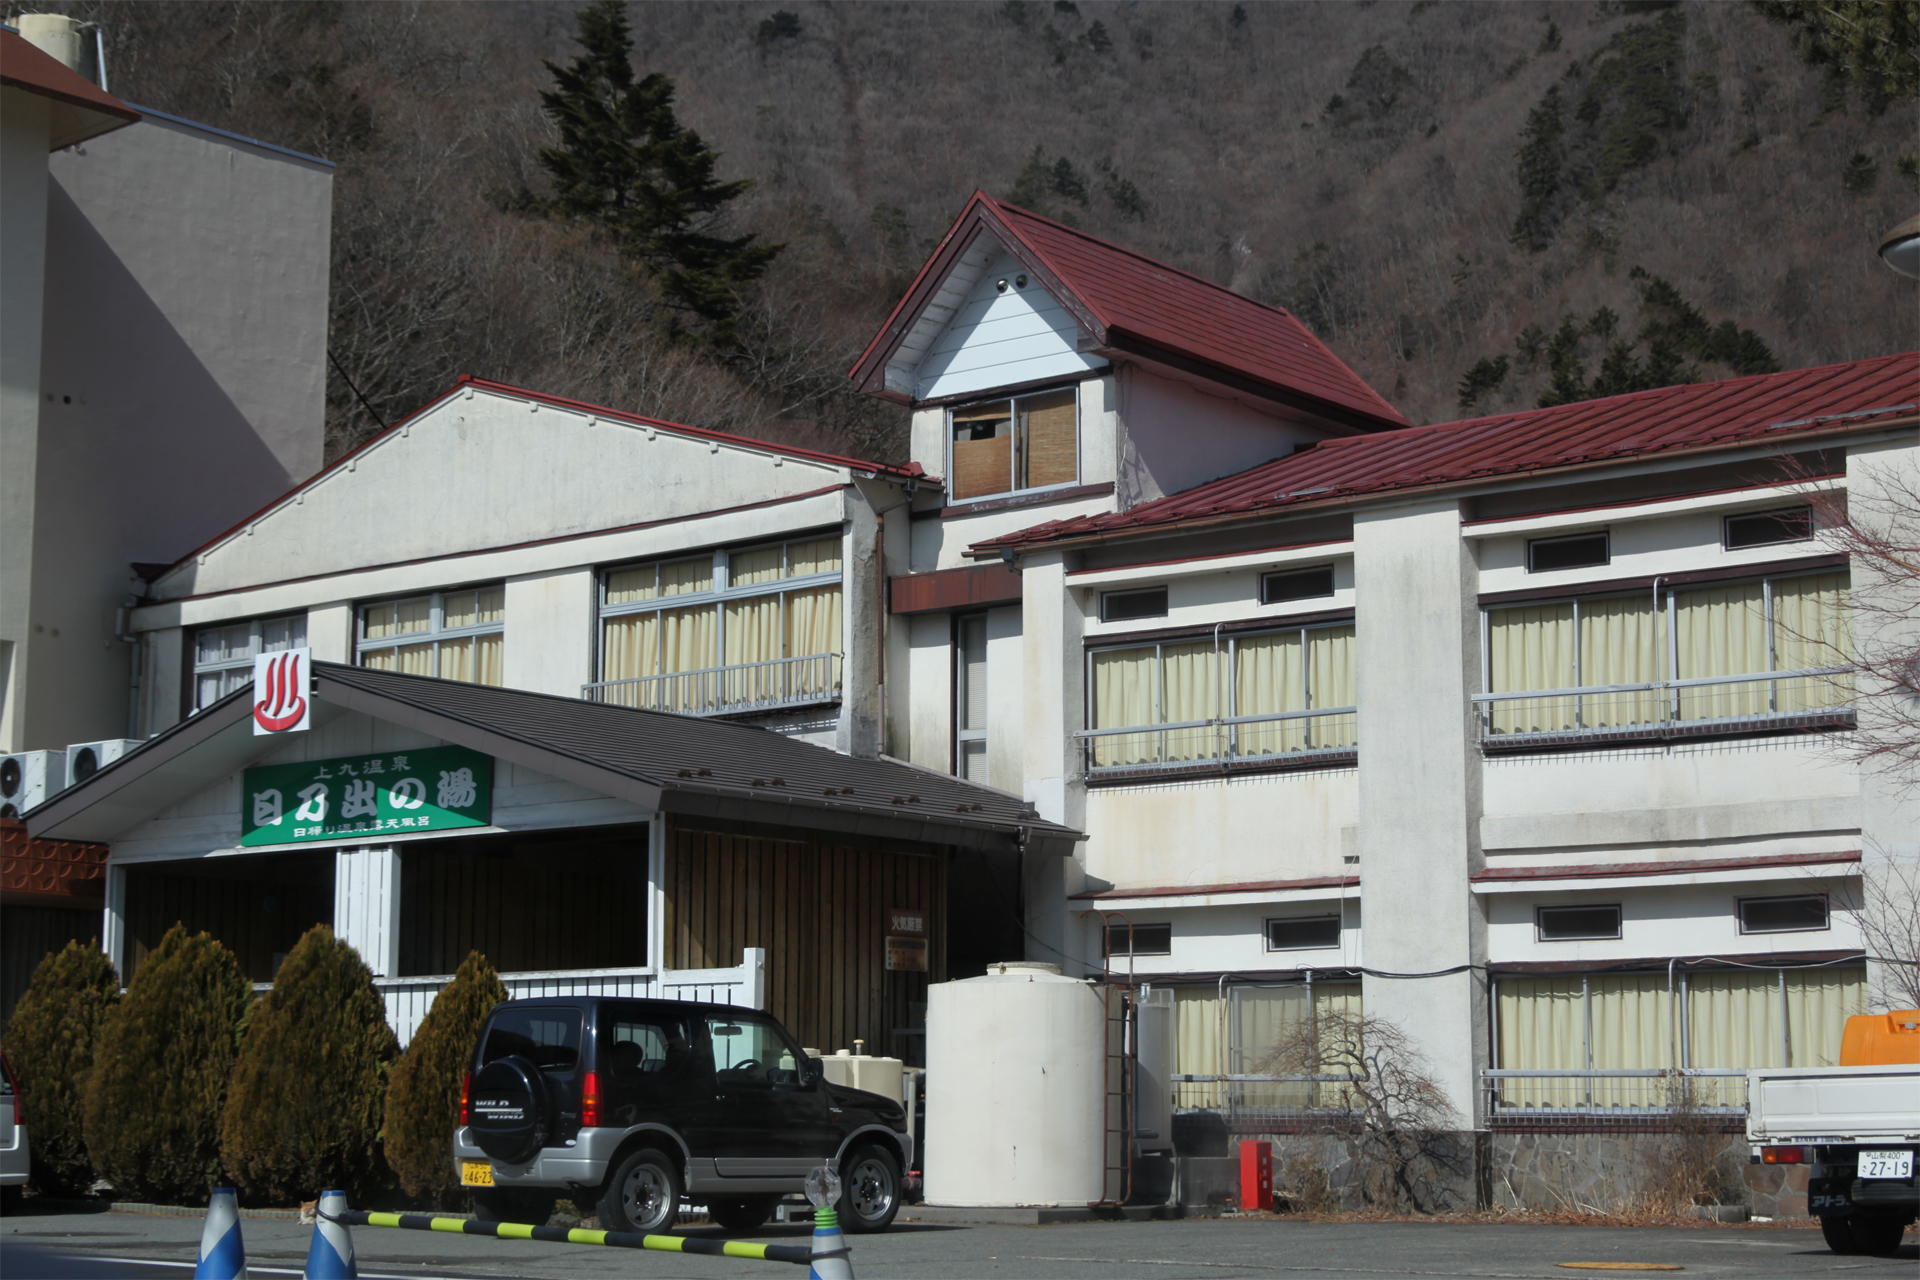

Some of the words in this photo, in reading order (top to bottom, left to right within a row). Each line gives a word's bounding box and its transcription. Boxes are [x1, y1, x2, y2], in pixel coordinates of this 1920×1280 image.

[314, 755, 411, 780] 上九温泉
[253, 767, 477, 827] 日乃出の湯
[293, 815, 430, 838] 日帰り温泉露天風呂
[891, 915, 923, 932] 火気厳禁
[475, 1100, 509, 1108] WILD
[487, 1112, 525, 1120] WIND
[1869, 1161, 1909, 1176] 27-19
[469, 1170, 492, 1184] 46-23
[1811, 1194, 1851, 1207] アトラ
